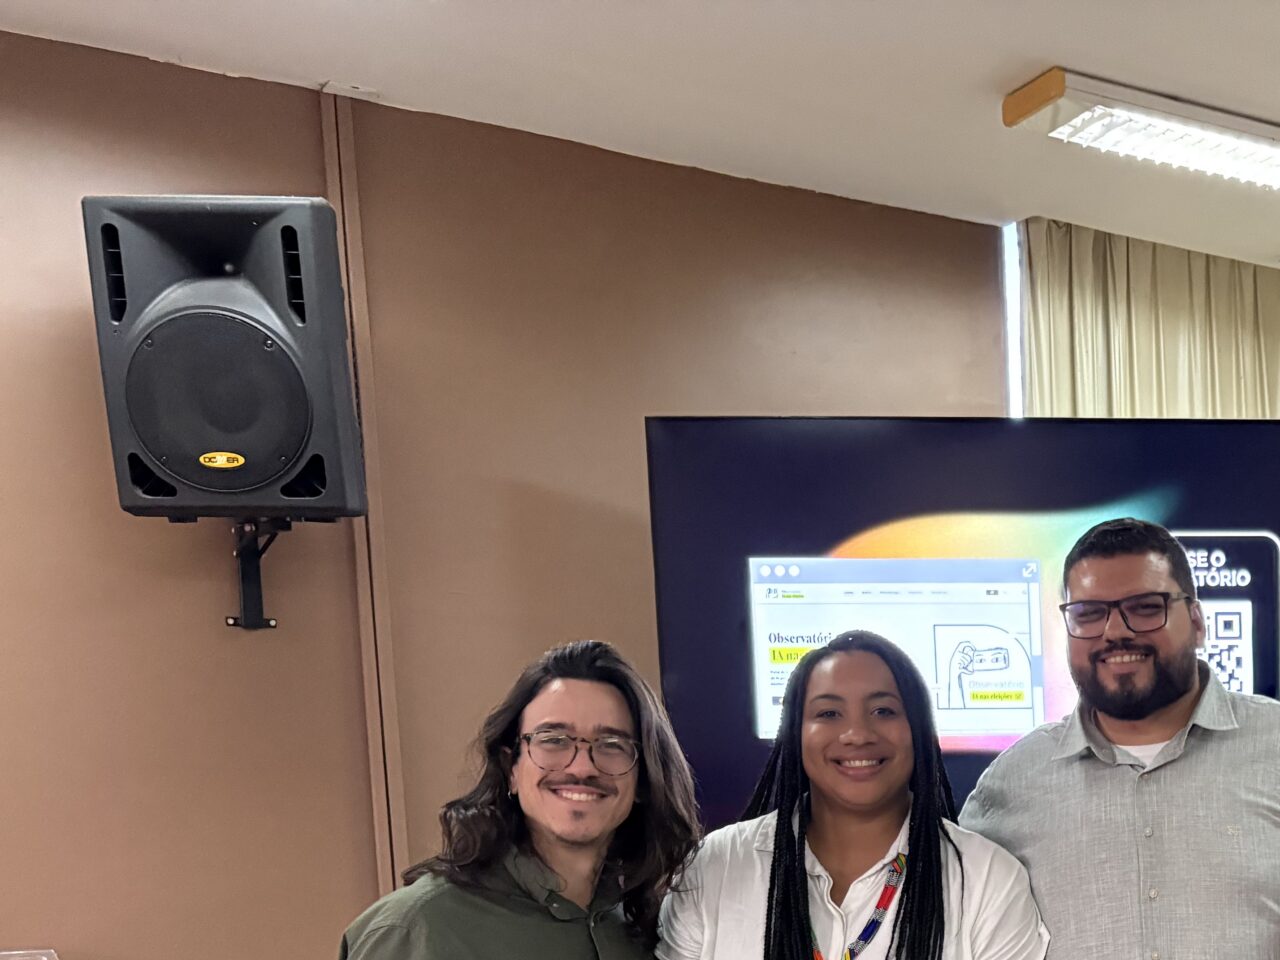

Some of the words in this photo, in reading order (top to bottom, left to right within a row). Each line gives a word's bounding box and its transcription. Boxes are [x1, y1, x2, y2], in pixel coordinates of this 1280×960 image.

[1187, 549, 1209, 568] SE
[1210, 549, 1227, 568] O
[768, 632, 832, 644] Observatóri
